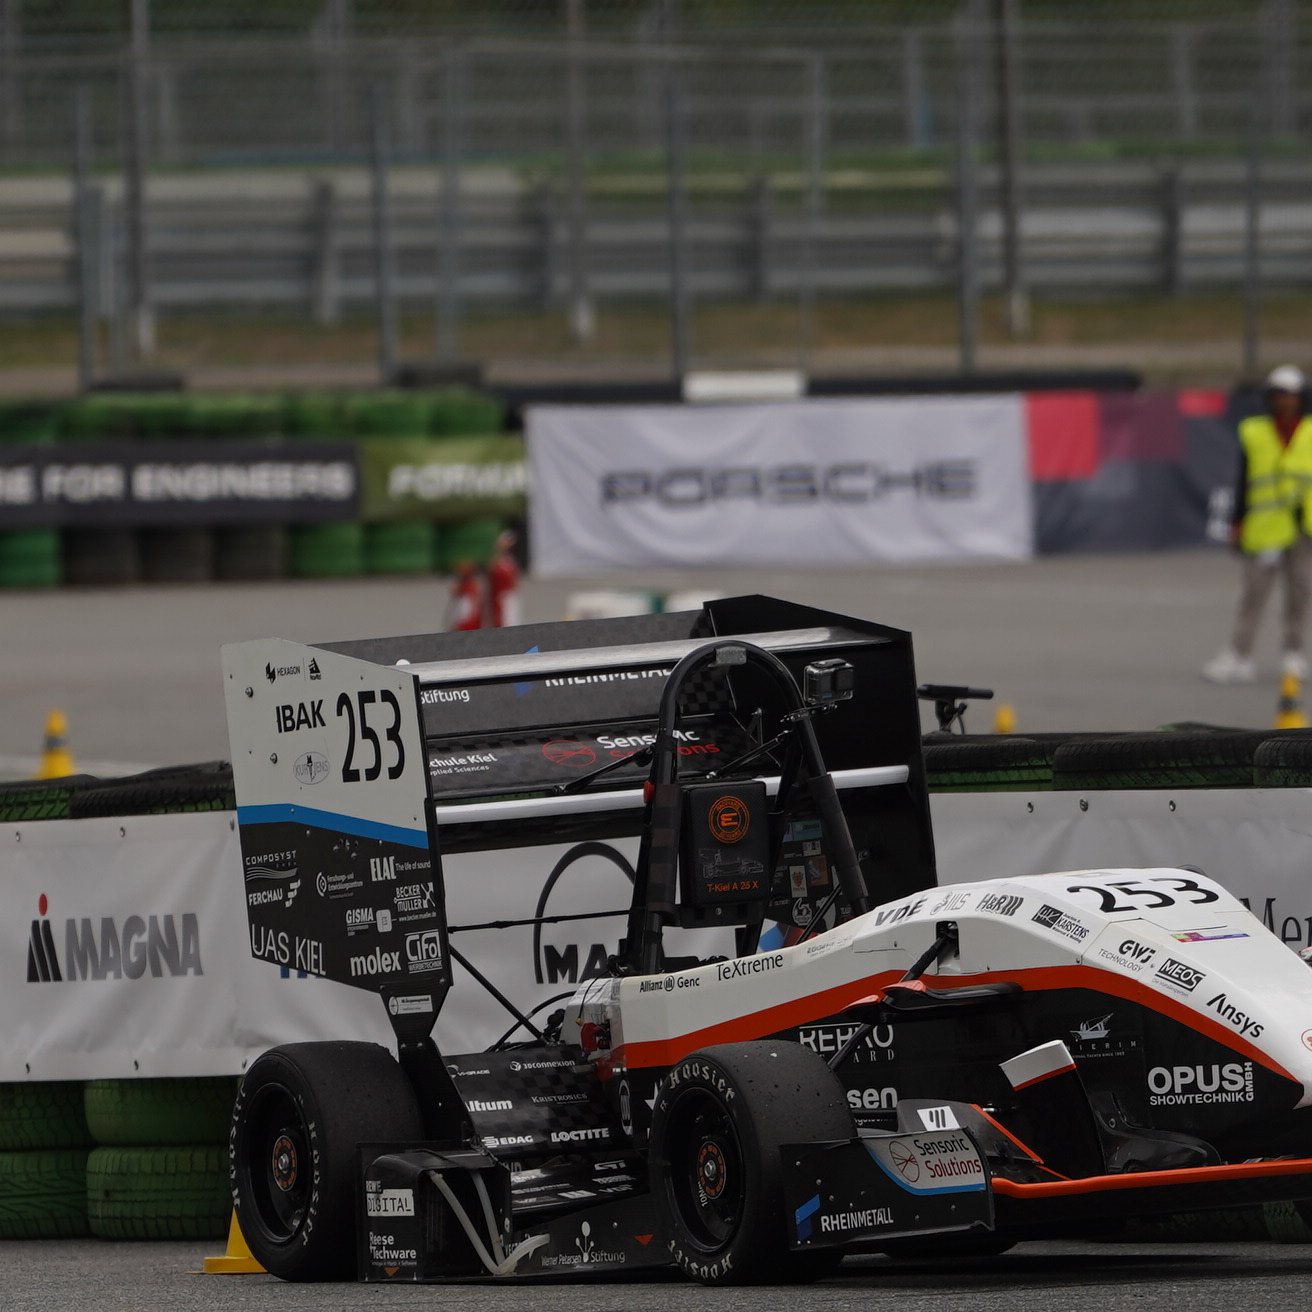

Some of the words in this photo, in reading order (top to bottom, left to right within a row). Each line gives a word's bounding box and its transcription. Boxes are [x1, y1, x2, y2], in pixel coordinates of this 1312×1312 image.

[41, 462, 126, 501] FOR
[131, 460, 357, 501] ENGINEERS
[602, 459, 977, 505] PORSCHE
[277, 666, 300, 677] HEXAGON
[275, 699, 327, 734] IBAK
[336, 689, 405, 783] 253
[454, 764, 490, 774] Sciences
[467, 752, 497, 765] Kiel
[245, 850, 297, 866] COMPOSYST
[248, 888, 284, 907] FERCHAU
[395, 884, 421, 899] BECKER
[707, 883, 730, 893] T-Kiel
[732, 882, 738, 890] A
[741, 882, 751, 890] 25
[1066, 877, 1220, 913] 253
[345, 907, 374, 924] GISMA
[875, 897, 928, 927] VDE
[1055, 916, 1090, 940] KARSTENS
[64, 912, 205, 982] MAGNA
[251, 923, 289, 964] UAS
[295, 936, 326, 976] KIEL
[349, 946, 402, 977] molex
[715, 954, 784, 981] TeXtreme
[1098, 948, 1144, 973] TECHNOLOGY
[640, 981, 663, 993] Allianz
[677, 976, 700, 989] Genc
[1206, 993, 1265, 1038] Ansys
[1147, 1062, 1245, 1095] OPUS
[1244, 1061, 1255, 1102] GMBH
[530, 1092, 589, 1104] KRISTRONICS
[1149, 1091, 1245, 1107] SHOWTECHNIK
[500, 1135, 534, 1145] EDAG
[550, 1127, 610, 1143] LOCTITE
[913, 1134, 970, 1157] Sensoric
[924, 1157, 982, 1179] Solutions
[367, 1196, 414, 1214] DIGITAL
[820, 1206, 895, 1233] RHEINMETALL
[368, 1231, 395, 1246] Reese
[541, 1254, 558, 1267] Werner
[558, 1252, 582, 1266] Petersen
[590, 1250, 626, 1264] Stiftung
